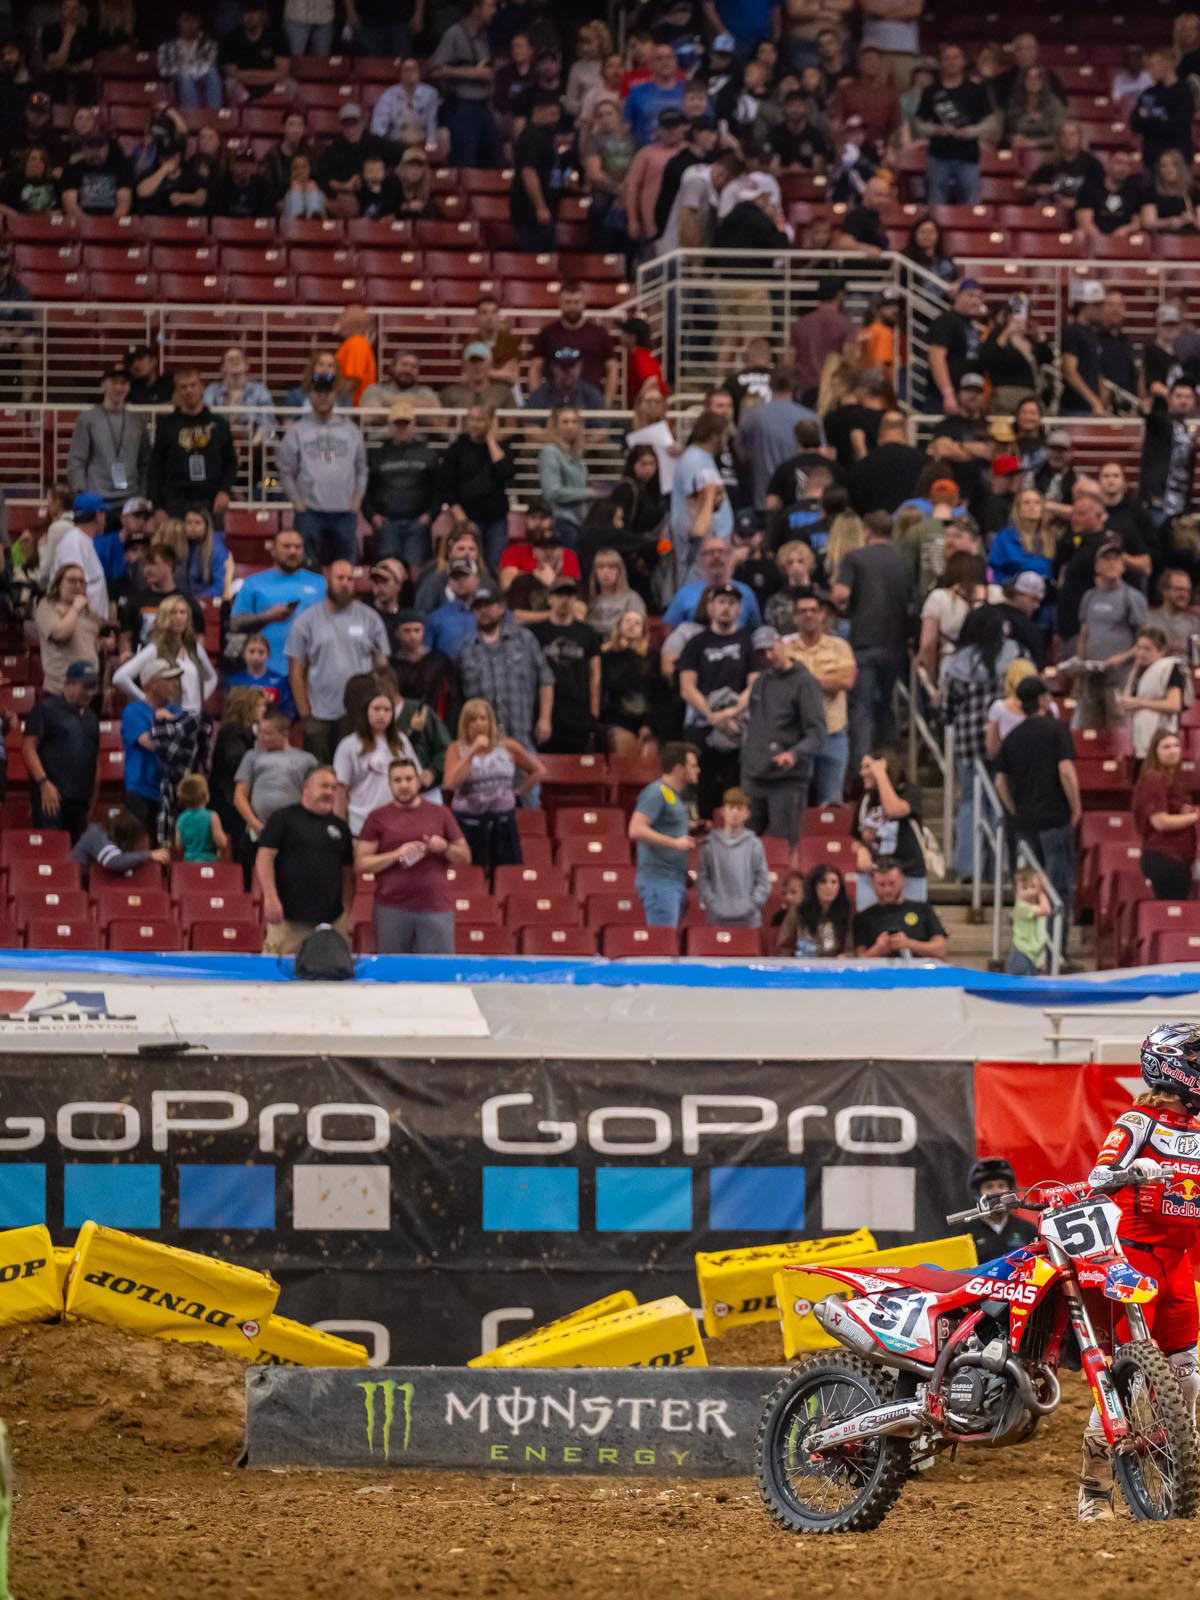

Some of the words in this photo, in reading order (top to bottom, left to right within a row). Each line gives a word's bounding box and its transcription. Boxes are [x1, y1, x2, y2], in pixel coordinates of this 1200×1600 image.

[481, 1092, 918, 1155] GoPro
[1053, 1206, 1114, 1256] 51
[84, 1270, 236, 1329] DUNLOP
[965, 1277, 1038, 1304] GASGAS
[490, 1444, 689, 1466] ENERGY
